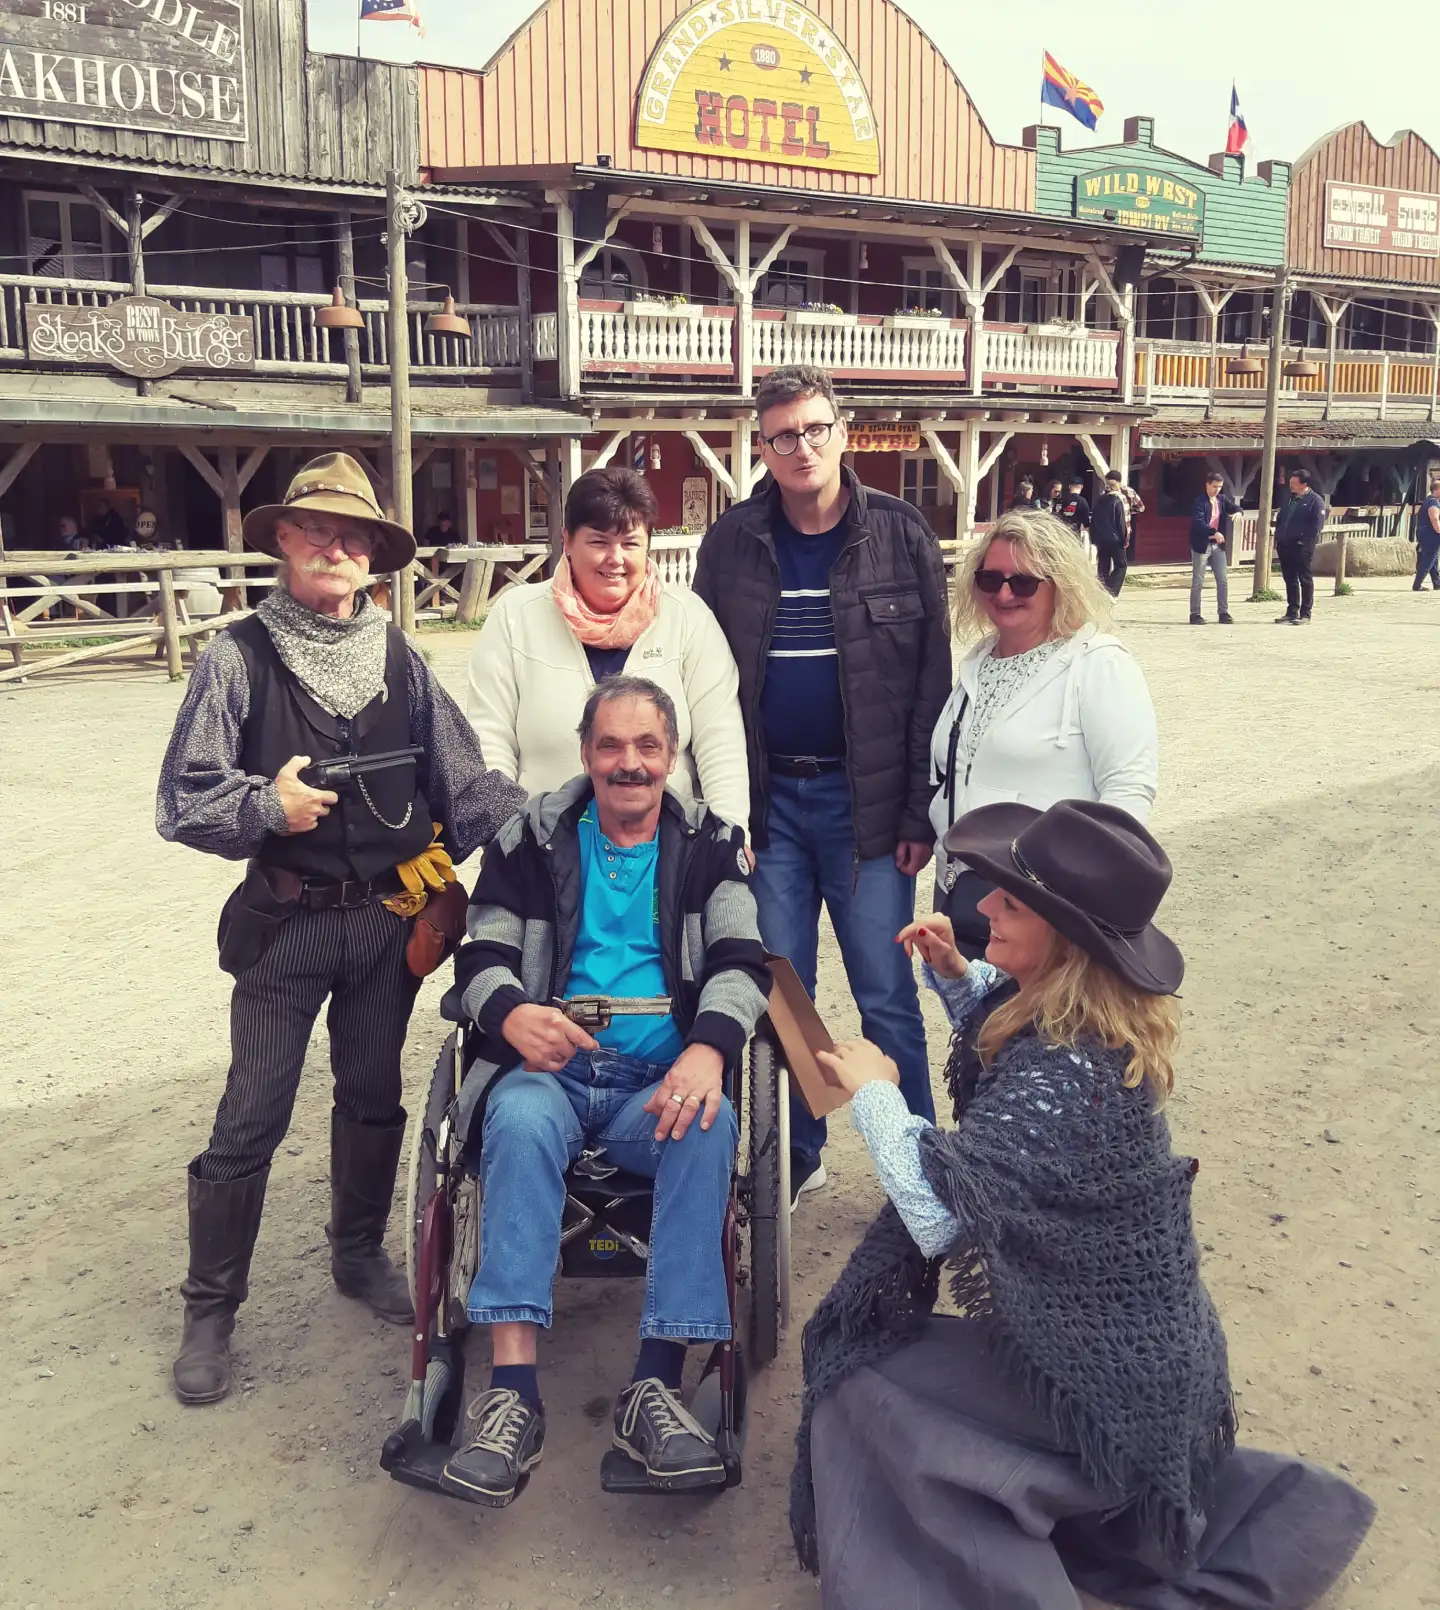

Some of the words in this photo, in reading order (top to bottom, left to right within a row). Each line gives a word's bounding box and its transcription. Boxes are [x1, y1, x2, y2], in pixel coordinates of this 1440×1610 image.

[42, 0, 87, 25] 1881
[645, 16, 708, 119] GRAND
[716, 0, 819, 45] SILVER
[825, 47, 873, 139] STAR
[695, 89, 830, 159] HOTEL
[1085, 173, 1139, 197] WILD
[126, 305, 161, 329] BEST
[127, 328, 135, 342] IN
[136, 329, 160, 343] TOWN
[162, 316, 252, 368] Burger
[868, 423, 896, 433] SILVER
[898, 424, 917, 432] STAR
[588, 1239, 619, 1251] TEDi
